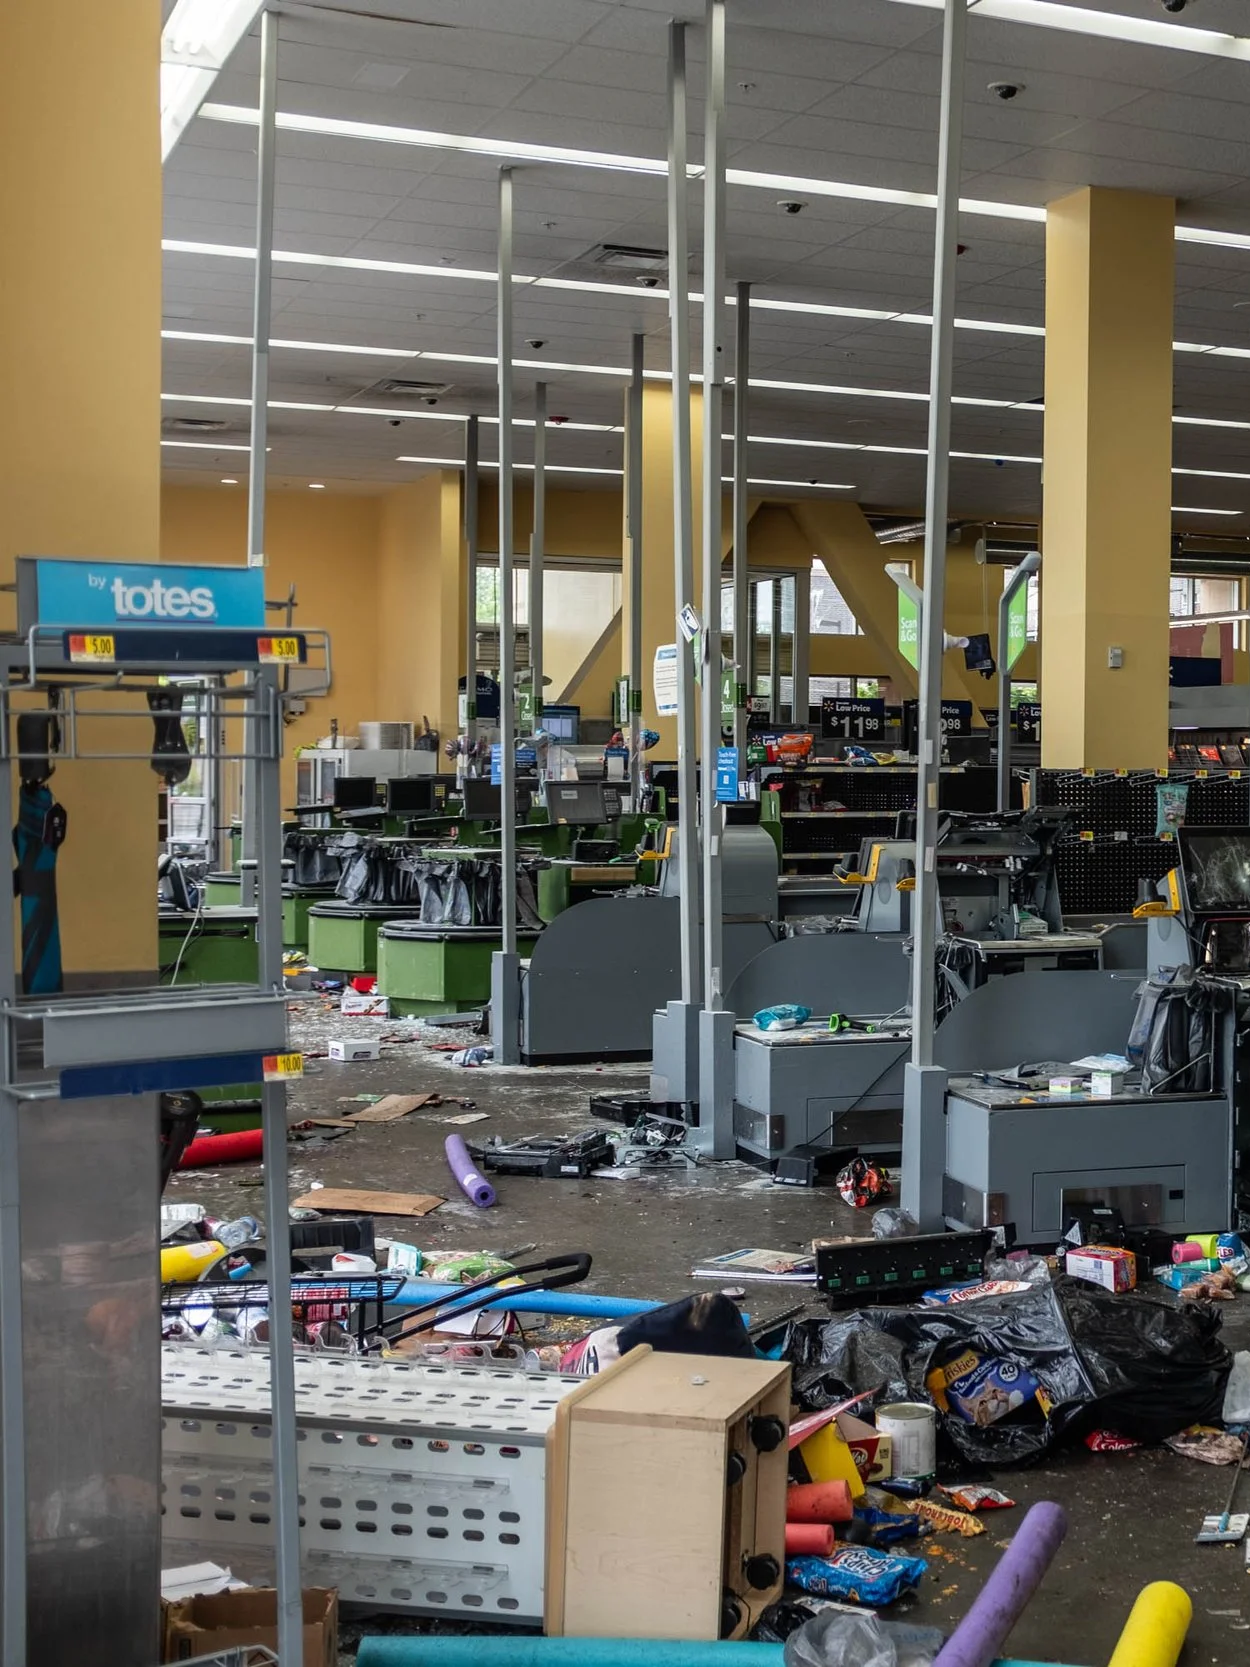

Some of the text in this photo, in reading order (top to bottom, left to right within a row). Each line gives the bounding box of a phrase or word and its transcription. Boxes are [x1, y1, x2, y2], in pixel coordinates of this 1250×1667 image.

[88, 573, 215, 617] by totes
[1009, 612, 1024, 624] Scan
[277, 640, 296, 656] 5.00
[723, 680, 730, 699] 4
[524, 693, 531, 709] 2
[1001, 1364, 1016, 1376] 40
